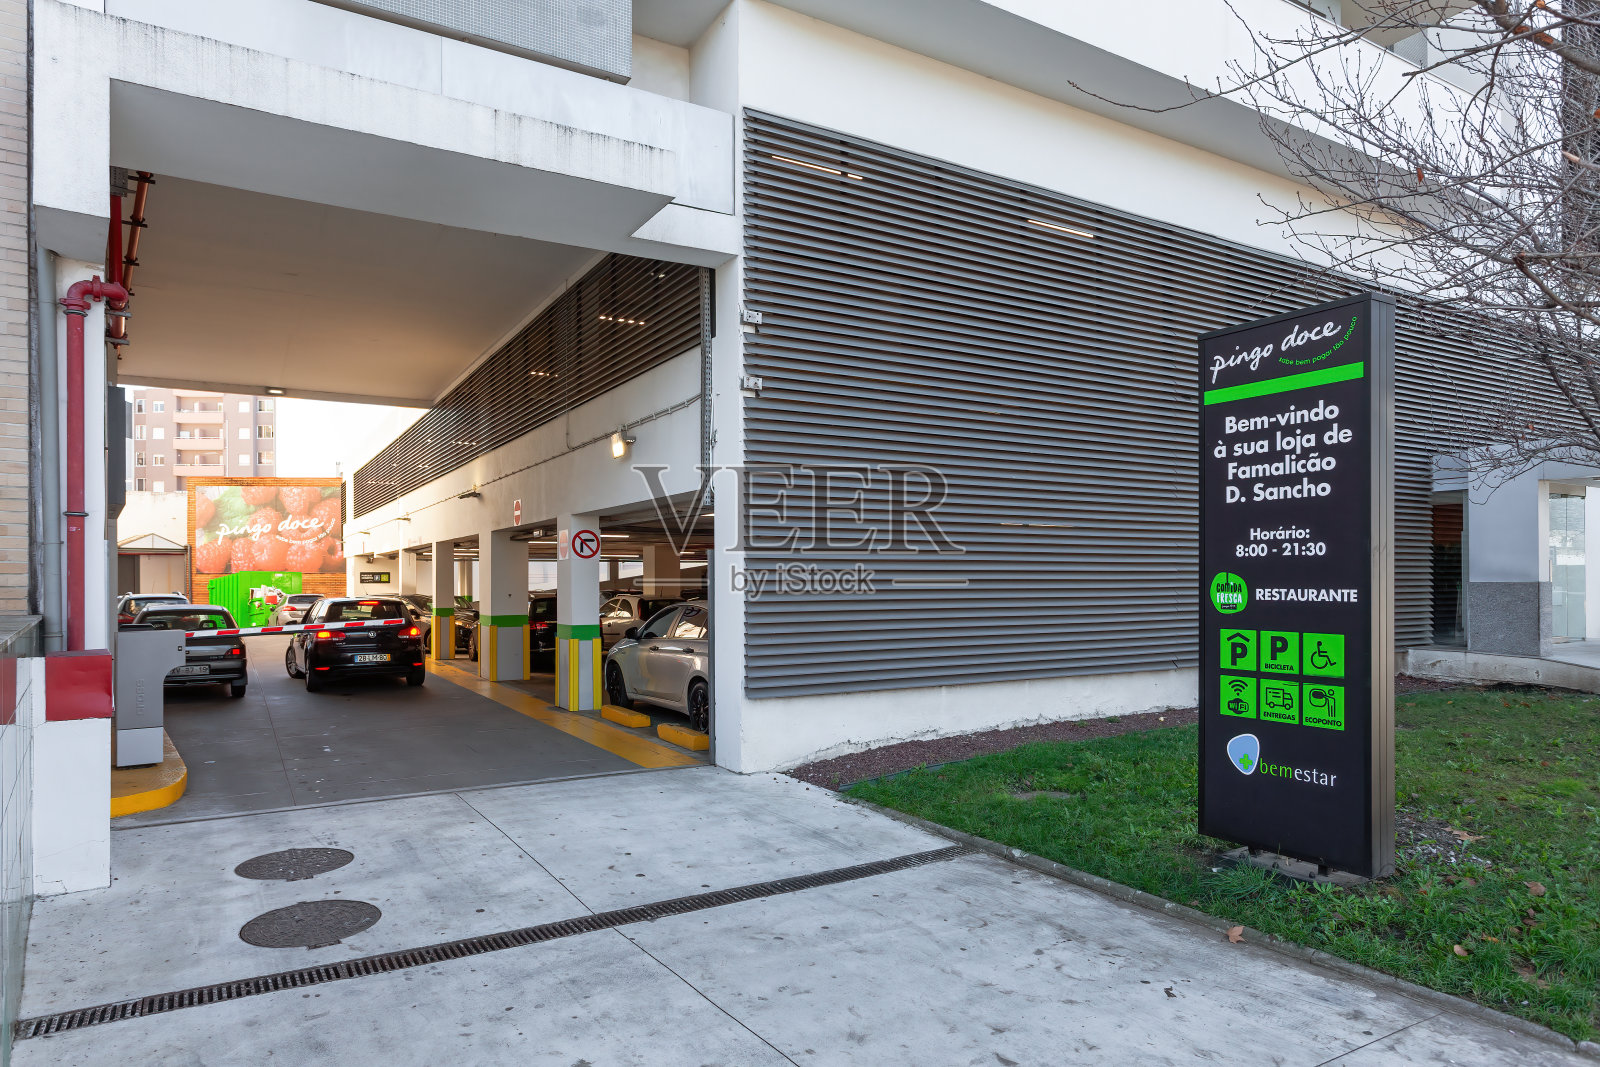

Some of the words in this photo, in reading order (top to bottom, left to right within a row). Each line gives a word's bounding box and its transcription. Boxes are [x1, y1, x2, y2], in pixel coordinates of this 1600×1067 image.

[1210, 343, 1273, 384] pingo
[1280, 321, 1342, 351] doce
[1295, 358, 1311, 366] bem
[1312, 349, 1333, 363] pagar
[1343, 316, 1358, 340] pouco
[1225, 399, 1340, 434] Bem-vindo
[1213, 439, 1227, 458] à
[1232, 439, 1269, 456] sua
[1276, 428, 1316, 454] loja
[1323, 423, 1353, 445] de
[1227, 452, 1337, 480] Famalicão
[1225, 485, 1246, 504] D.
[1253, 477, 1331, 501] Sancho
[216, 520, 272, 545] pingo
[278, 514, 325, 532] doce
[1250, 525, 1310, 540] Horário:
[1235, 543, 1268, 557] 8:00
[1282, 541, 1326, 556] 21:30
[1216, 592, 1243, 604] FRESCA
[1255, 588, 1358, 603] RESTAURANTE
[1230, 641, 1248, 666] P
[1270, 635, 1289, 660] P
[1264, 662, 1295, 671] BICICLETA
[1263, 711, 1296, 721] ENTREGAS
[1304, 716, 1342, 727] ECOPONTO
[1259, 757, 1337, 787] bemestar
